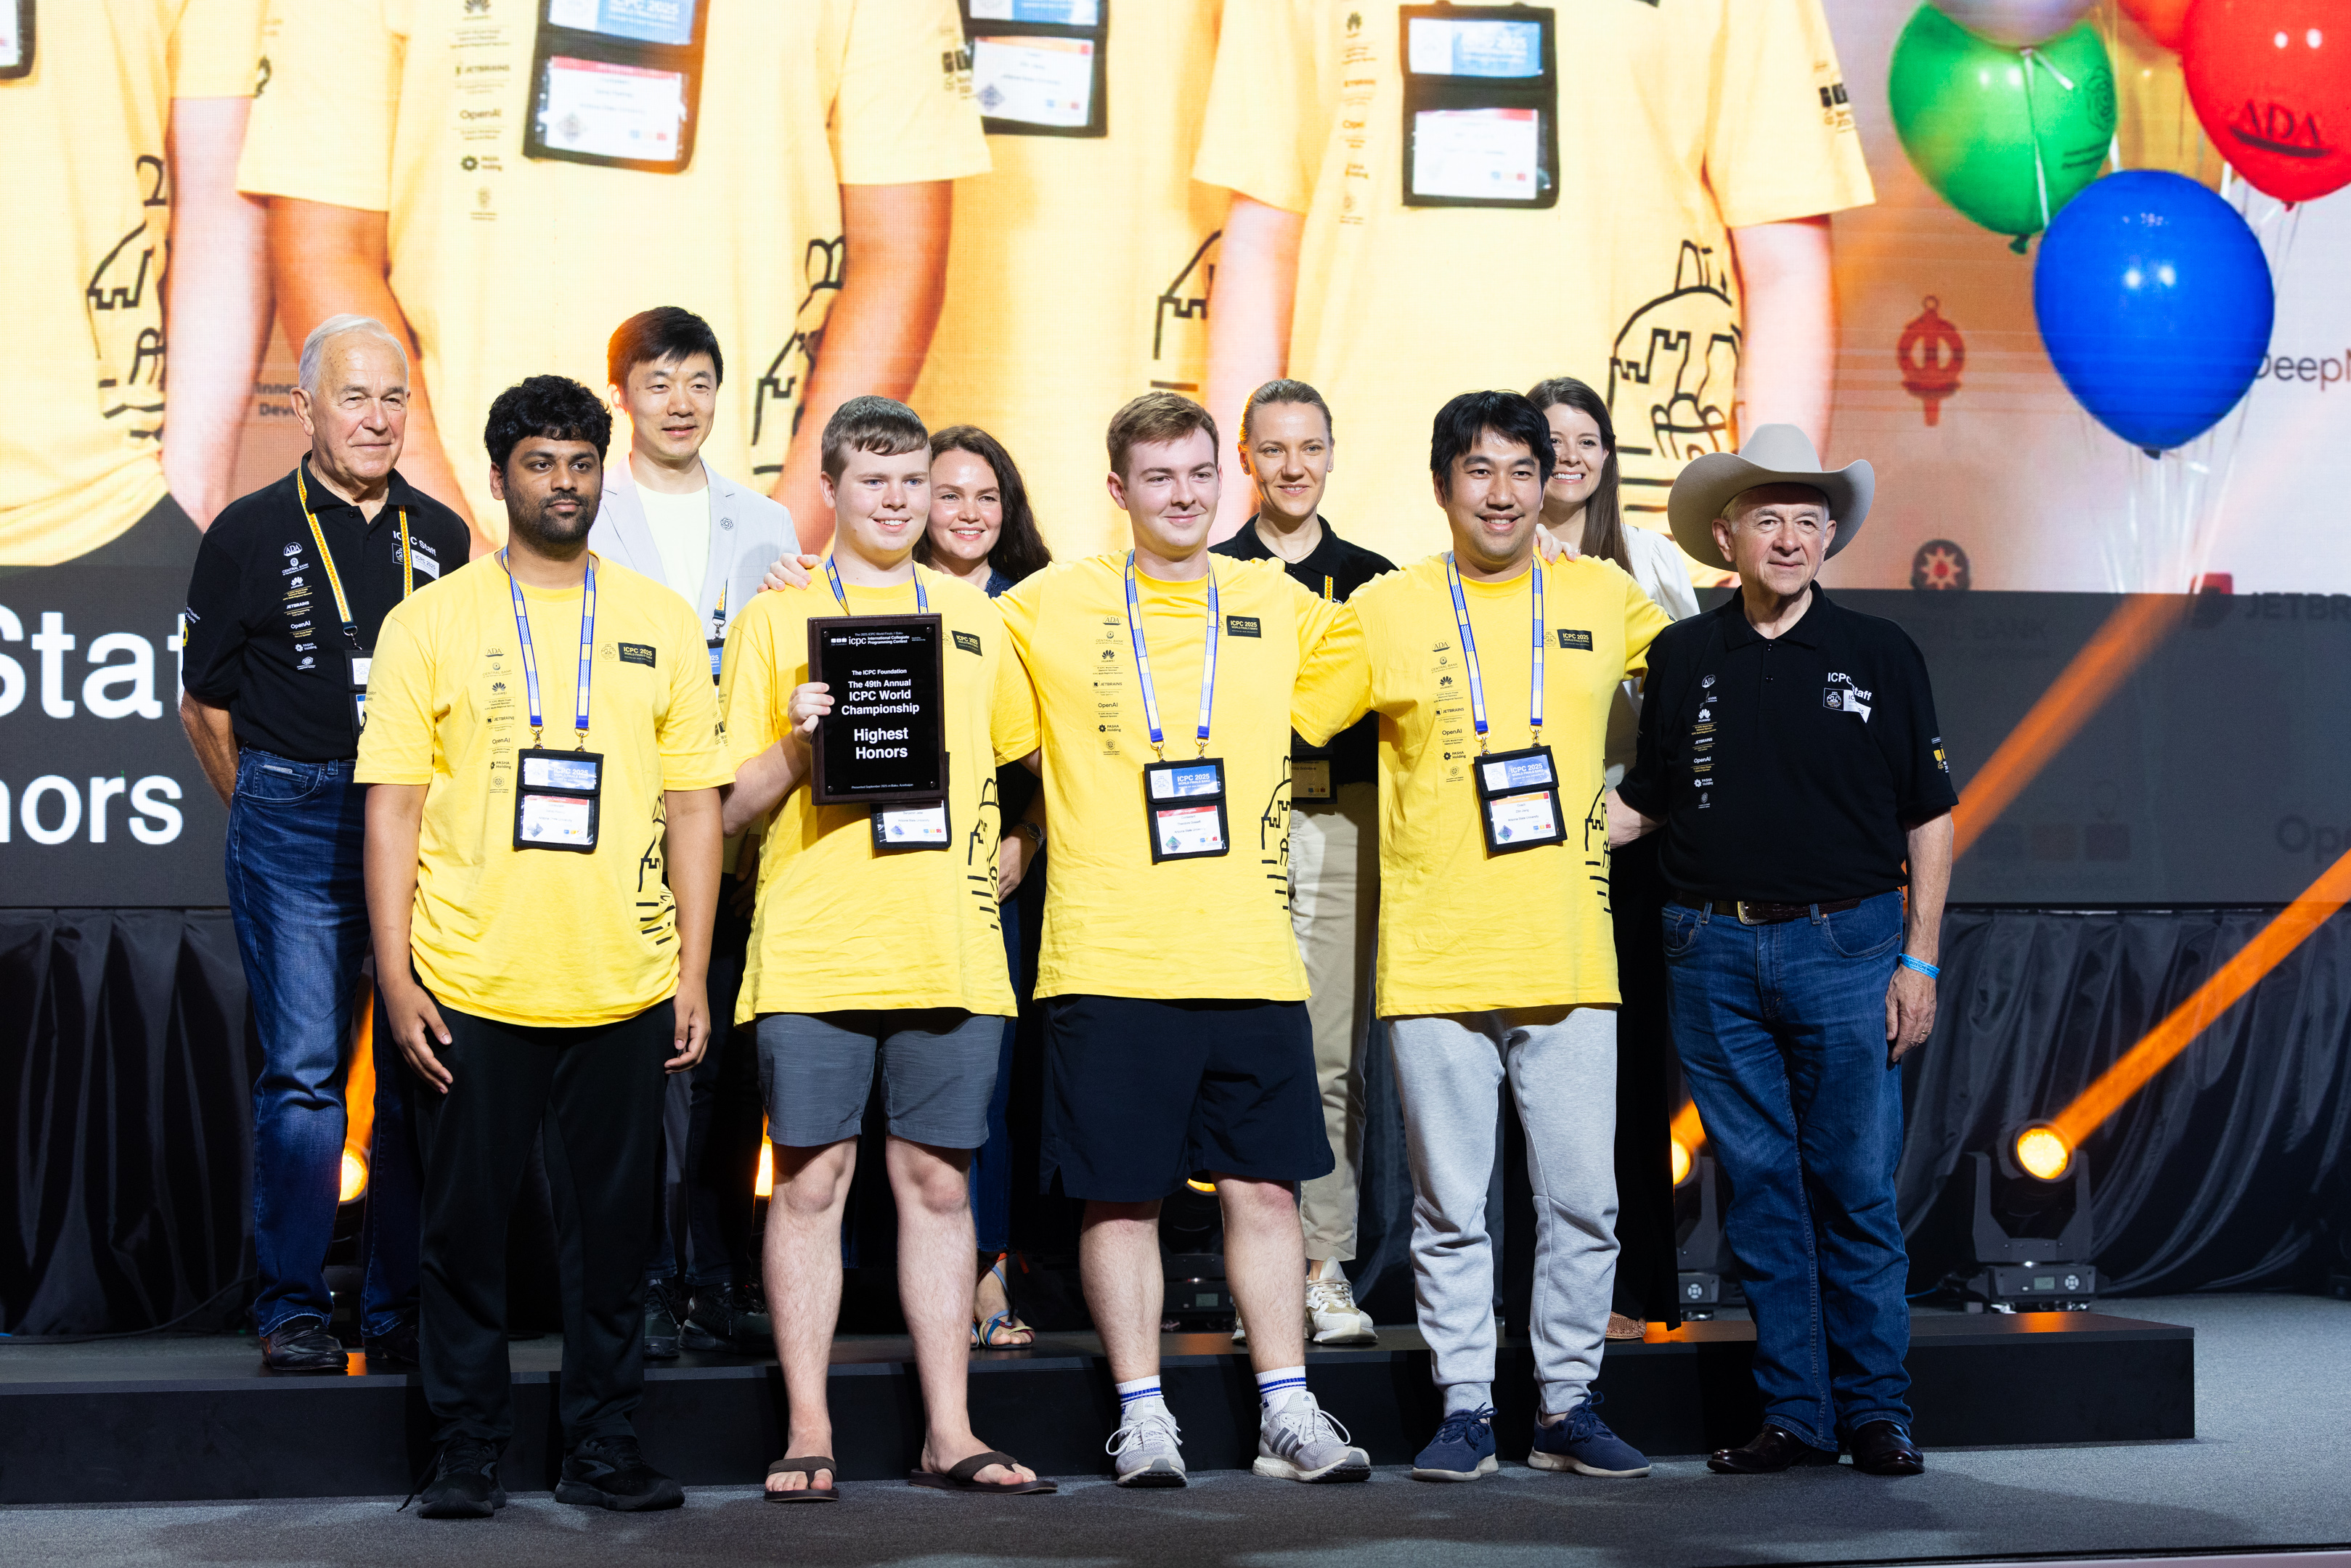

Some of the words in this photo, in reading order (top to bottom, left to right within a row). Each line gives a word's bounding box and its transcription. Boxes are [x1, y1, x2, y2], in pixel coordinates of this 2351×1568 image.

[2254, 348, 2351, 393] Deep
[286, 544, 300, 554] ADA
[393, 531, 418, 545] ICC
[419, 540, 436, 557] Staff
[290, 621, 311, 629] OpenAI
[848, 636, 866, 647] icpc
[1433, 642, 1449, 650] ADA
[849, 691, 876, 701] ICPC
[879, 690, 911, 701] World
[842, 703, 920, 716] Championship
[854, 727, 909, 744] Highest
[855, 746, 908, 759] Honors
[0, 775, 184, 845] ors
